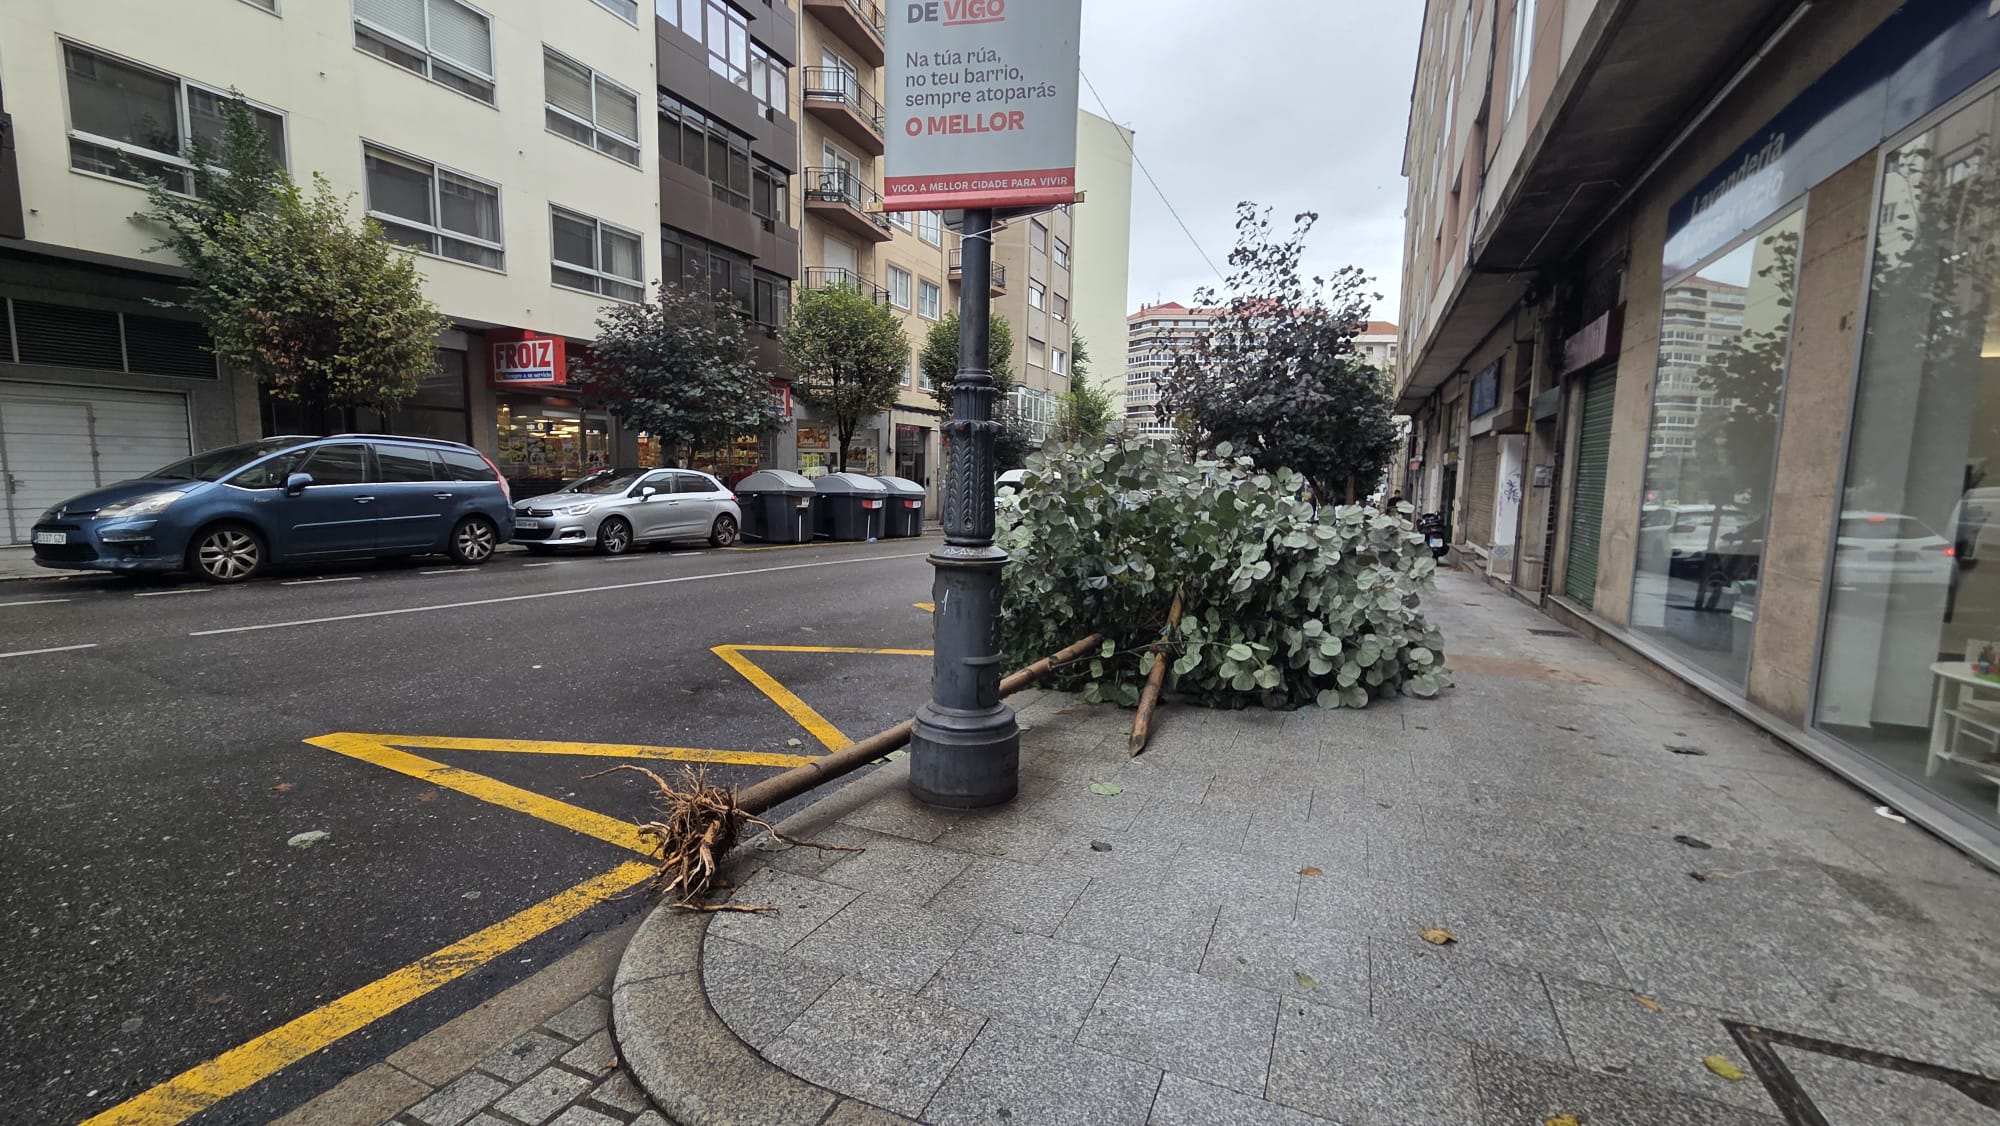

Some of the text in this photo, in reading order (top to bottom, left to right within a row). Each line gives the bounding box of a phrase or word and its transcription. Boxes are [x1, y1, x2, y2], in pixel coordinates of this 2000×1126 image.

[907, 0, 1006, 24] DE VIGO
[906, 47, 1001, 69] Na túa rúa,
[905, 64, 1024, 88] no teu barrio,
[905, 82, 1057, 109] sempre atoparás
[905, 110, 1025, 137] O MELLOR
[920, 183, 927, 192] A
[929, 181, 969, 192] MELLOR
[971, 179, 1009, 190] CIDADE
[1011, 178, 1037, 188] PARA
[1040, 176, 1067, 187] VIVIR
[495, 342, 551, 369] FROIZ
